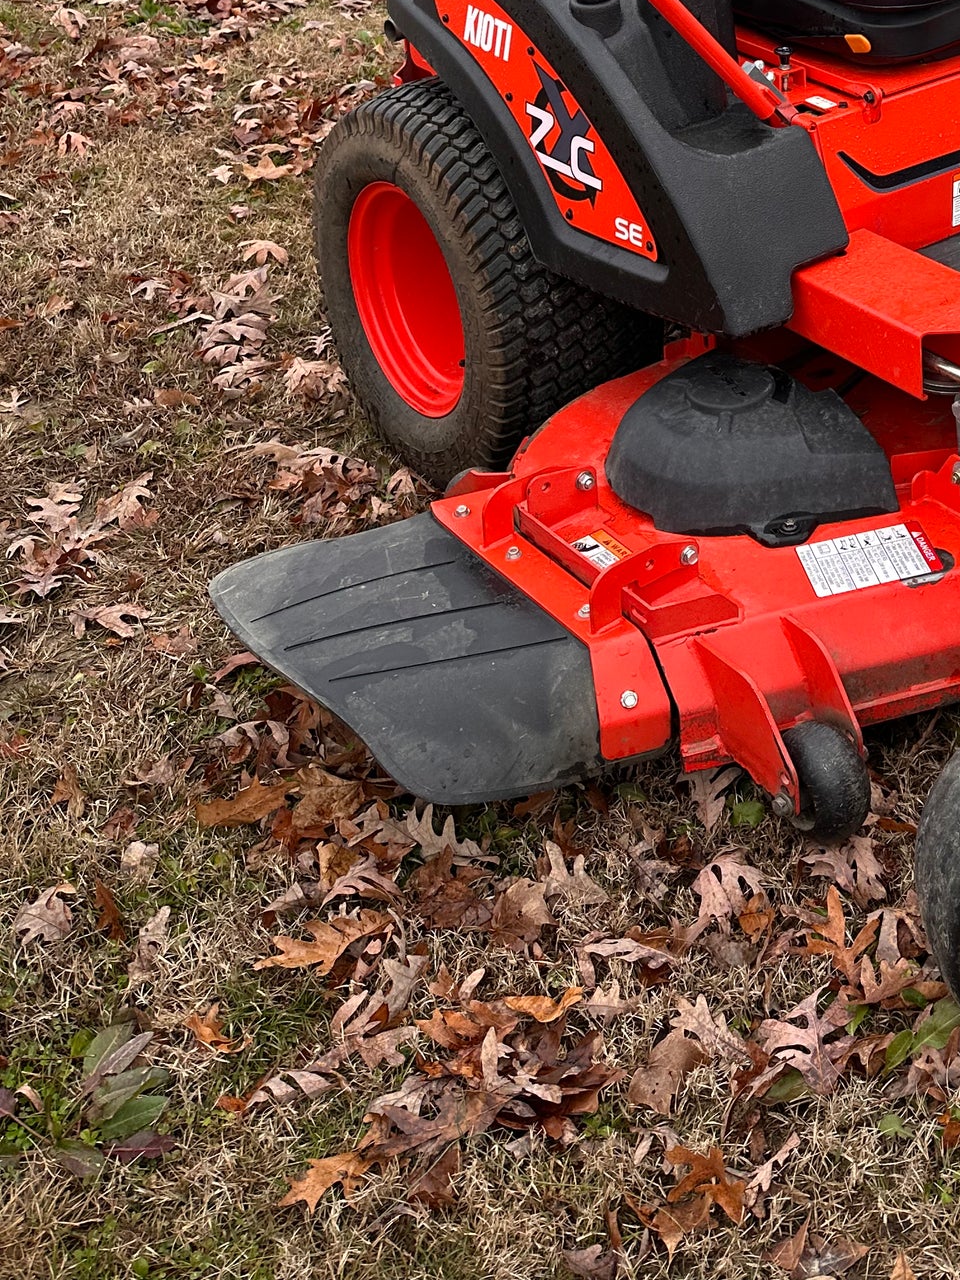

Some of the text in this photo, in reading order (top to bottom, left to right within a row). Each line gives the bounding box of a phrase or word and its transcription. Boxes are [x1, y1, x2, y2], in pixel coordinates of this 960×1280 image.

[463, 4, 513, 63] KIOTI
[614, 217, 643, 248] SE
[916, 536, 936, 562] DANGER
